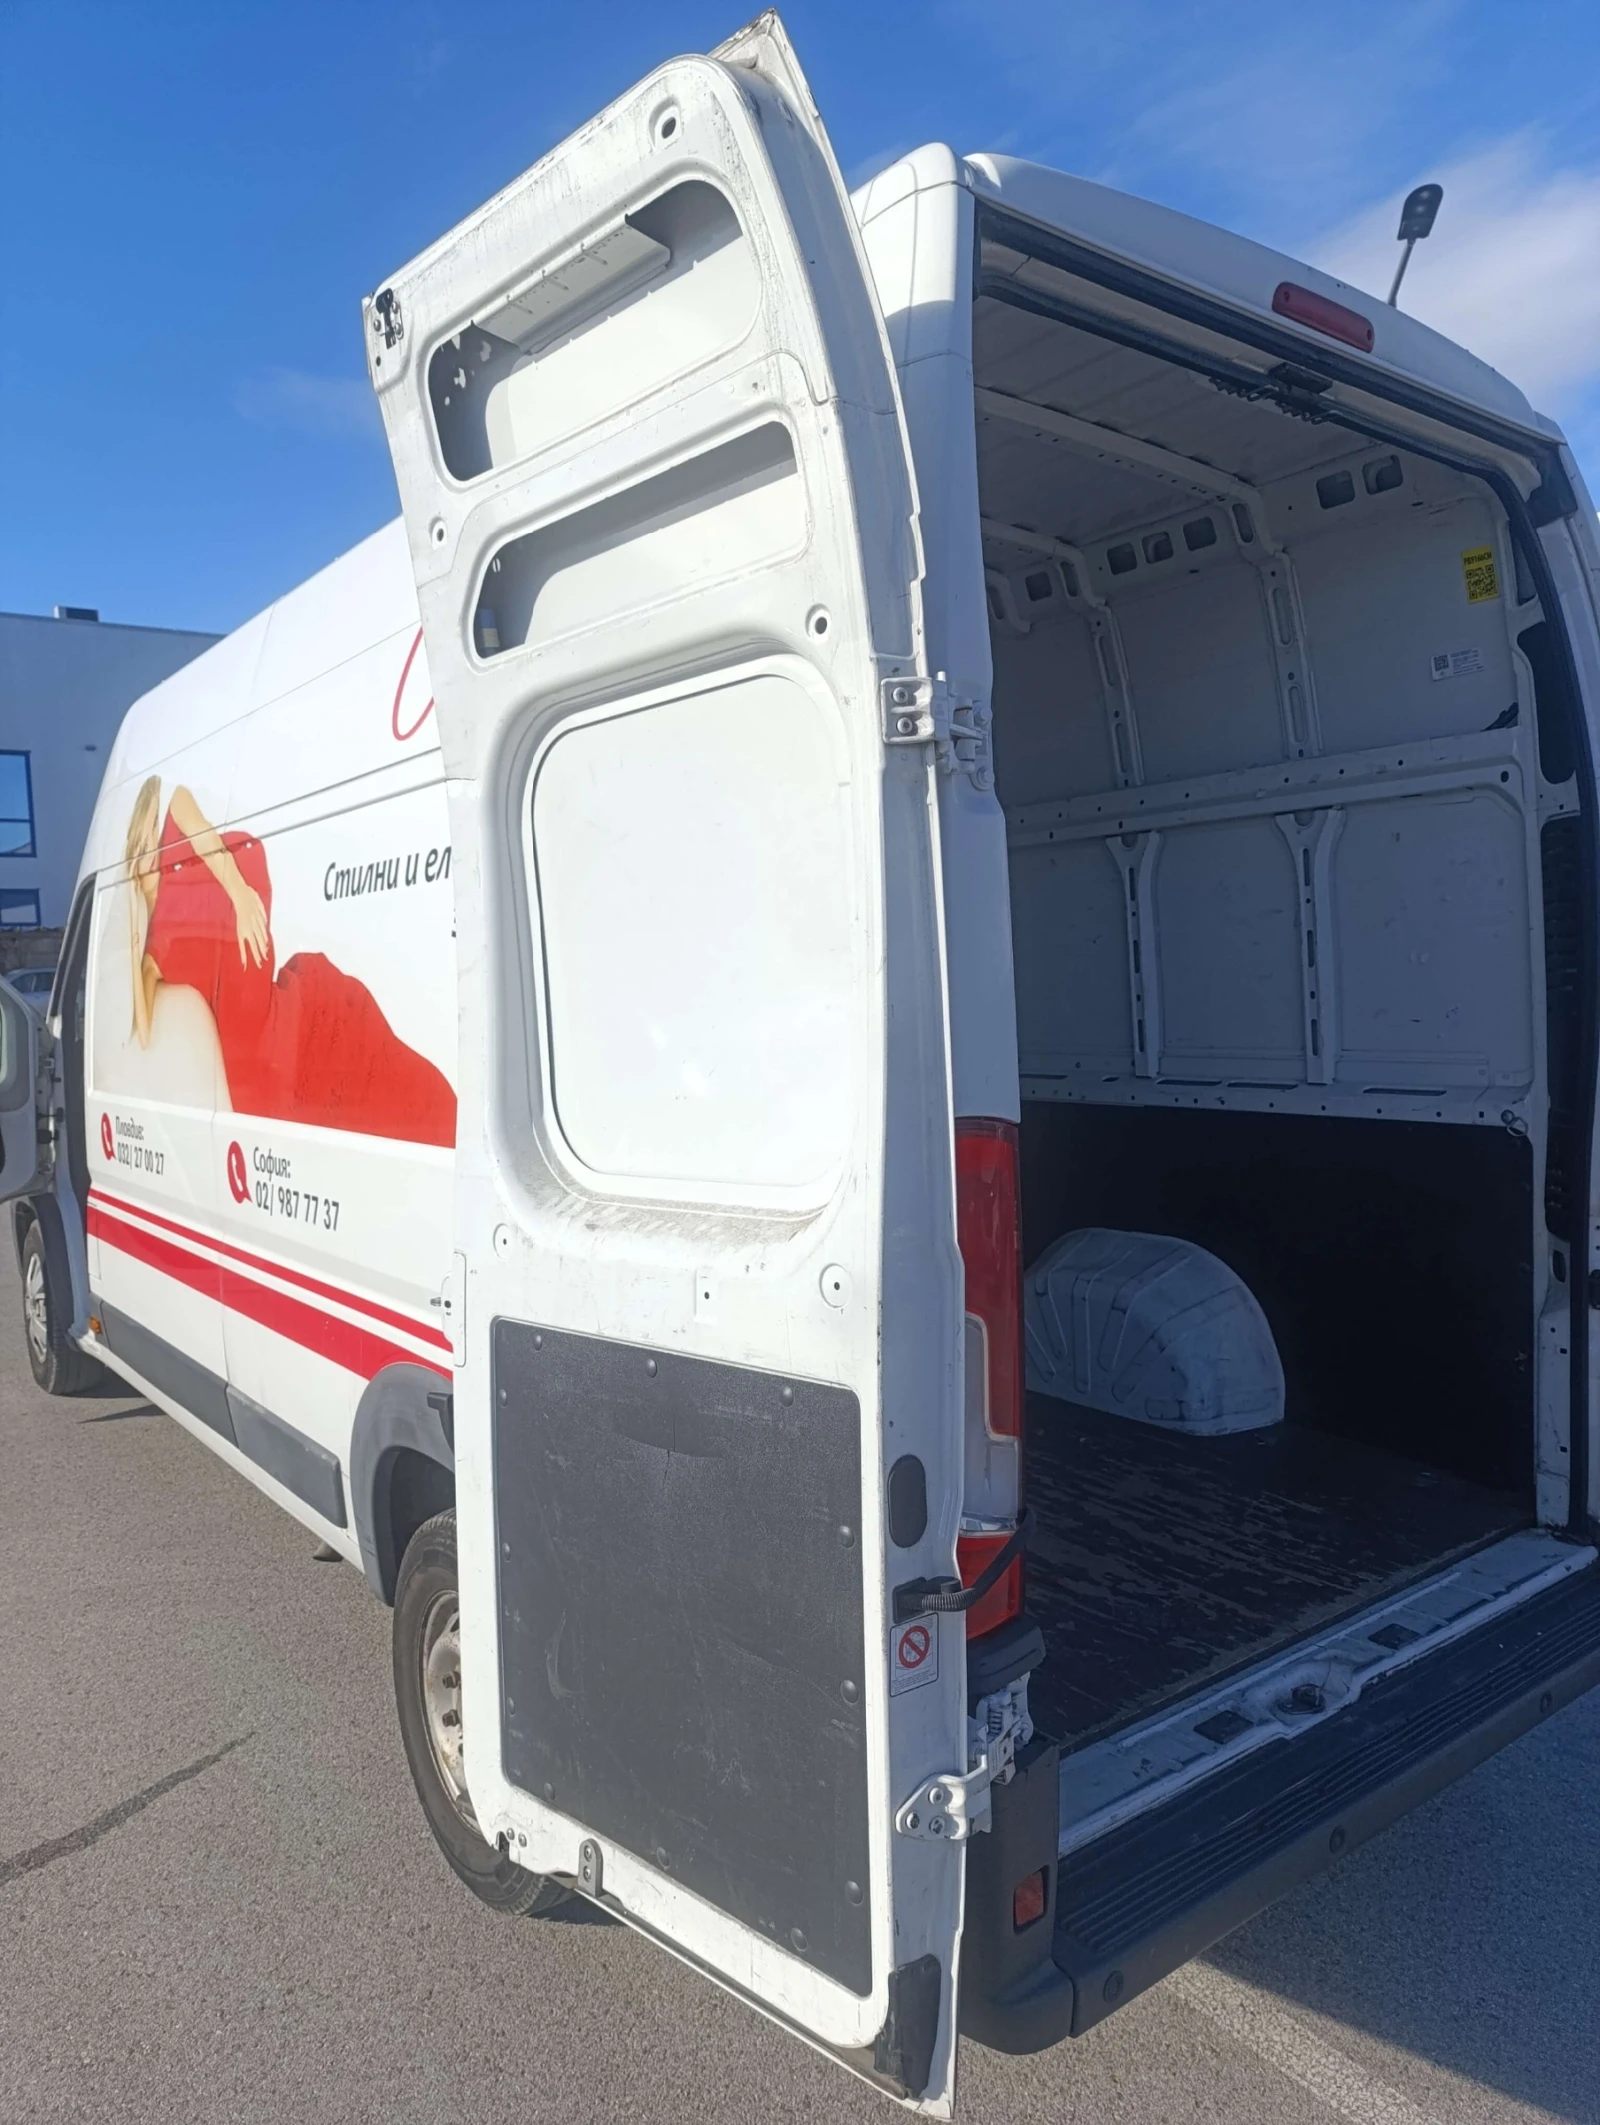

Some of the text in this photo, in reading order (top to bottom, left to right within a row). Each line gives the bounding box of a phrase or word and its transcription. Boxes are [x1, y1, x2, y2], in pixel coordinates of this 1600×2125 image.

[323, 857, 400, 901] Стилни
[405, 852, 420, 887] и
[134, 1146, 143, 1169] 27
[144, 1148, 154, 1173] 00
[155, 1151, 164, 1176] 27
[253, 1146, 291, 1182] София:
[278, 1186, 300, 1219] 987
[303, 1193, 319, 1226] 77
[323, 1198, 340, 1231] 37
